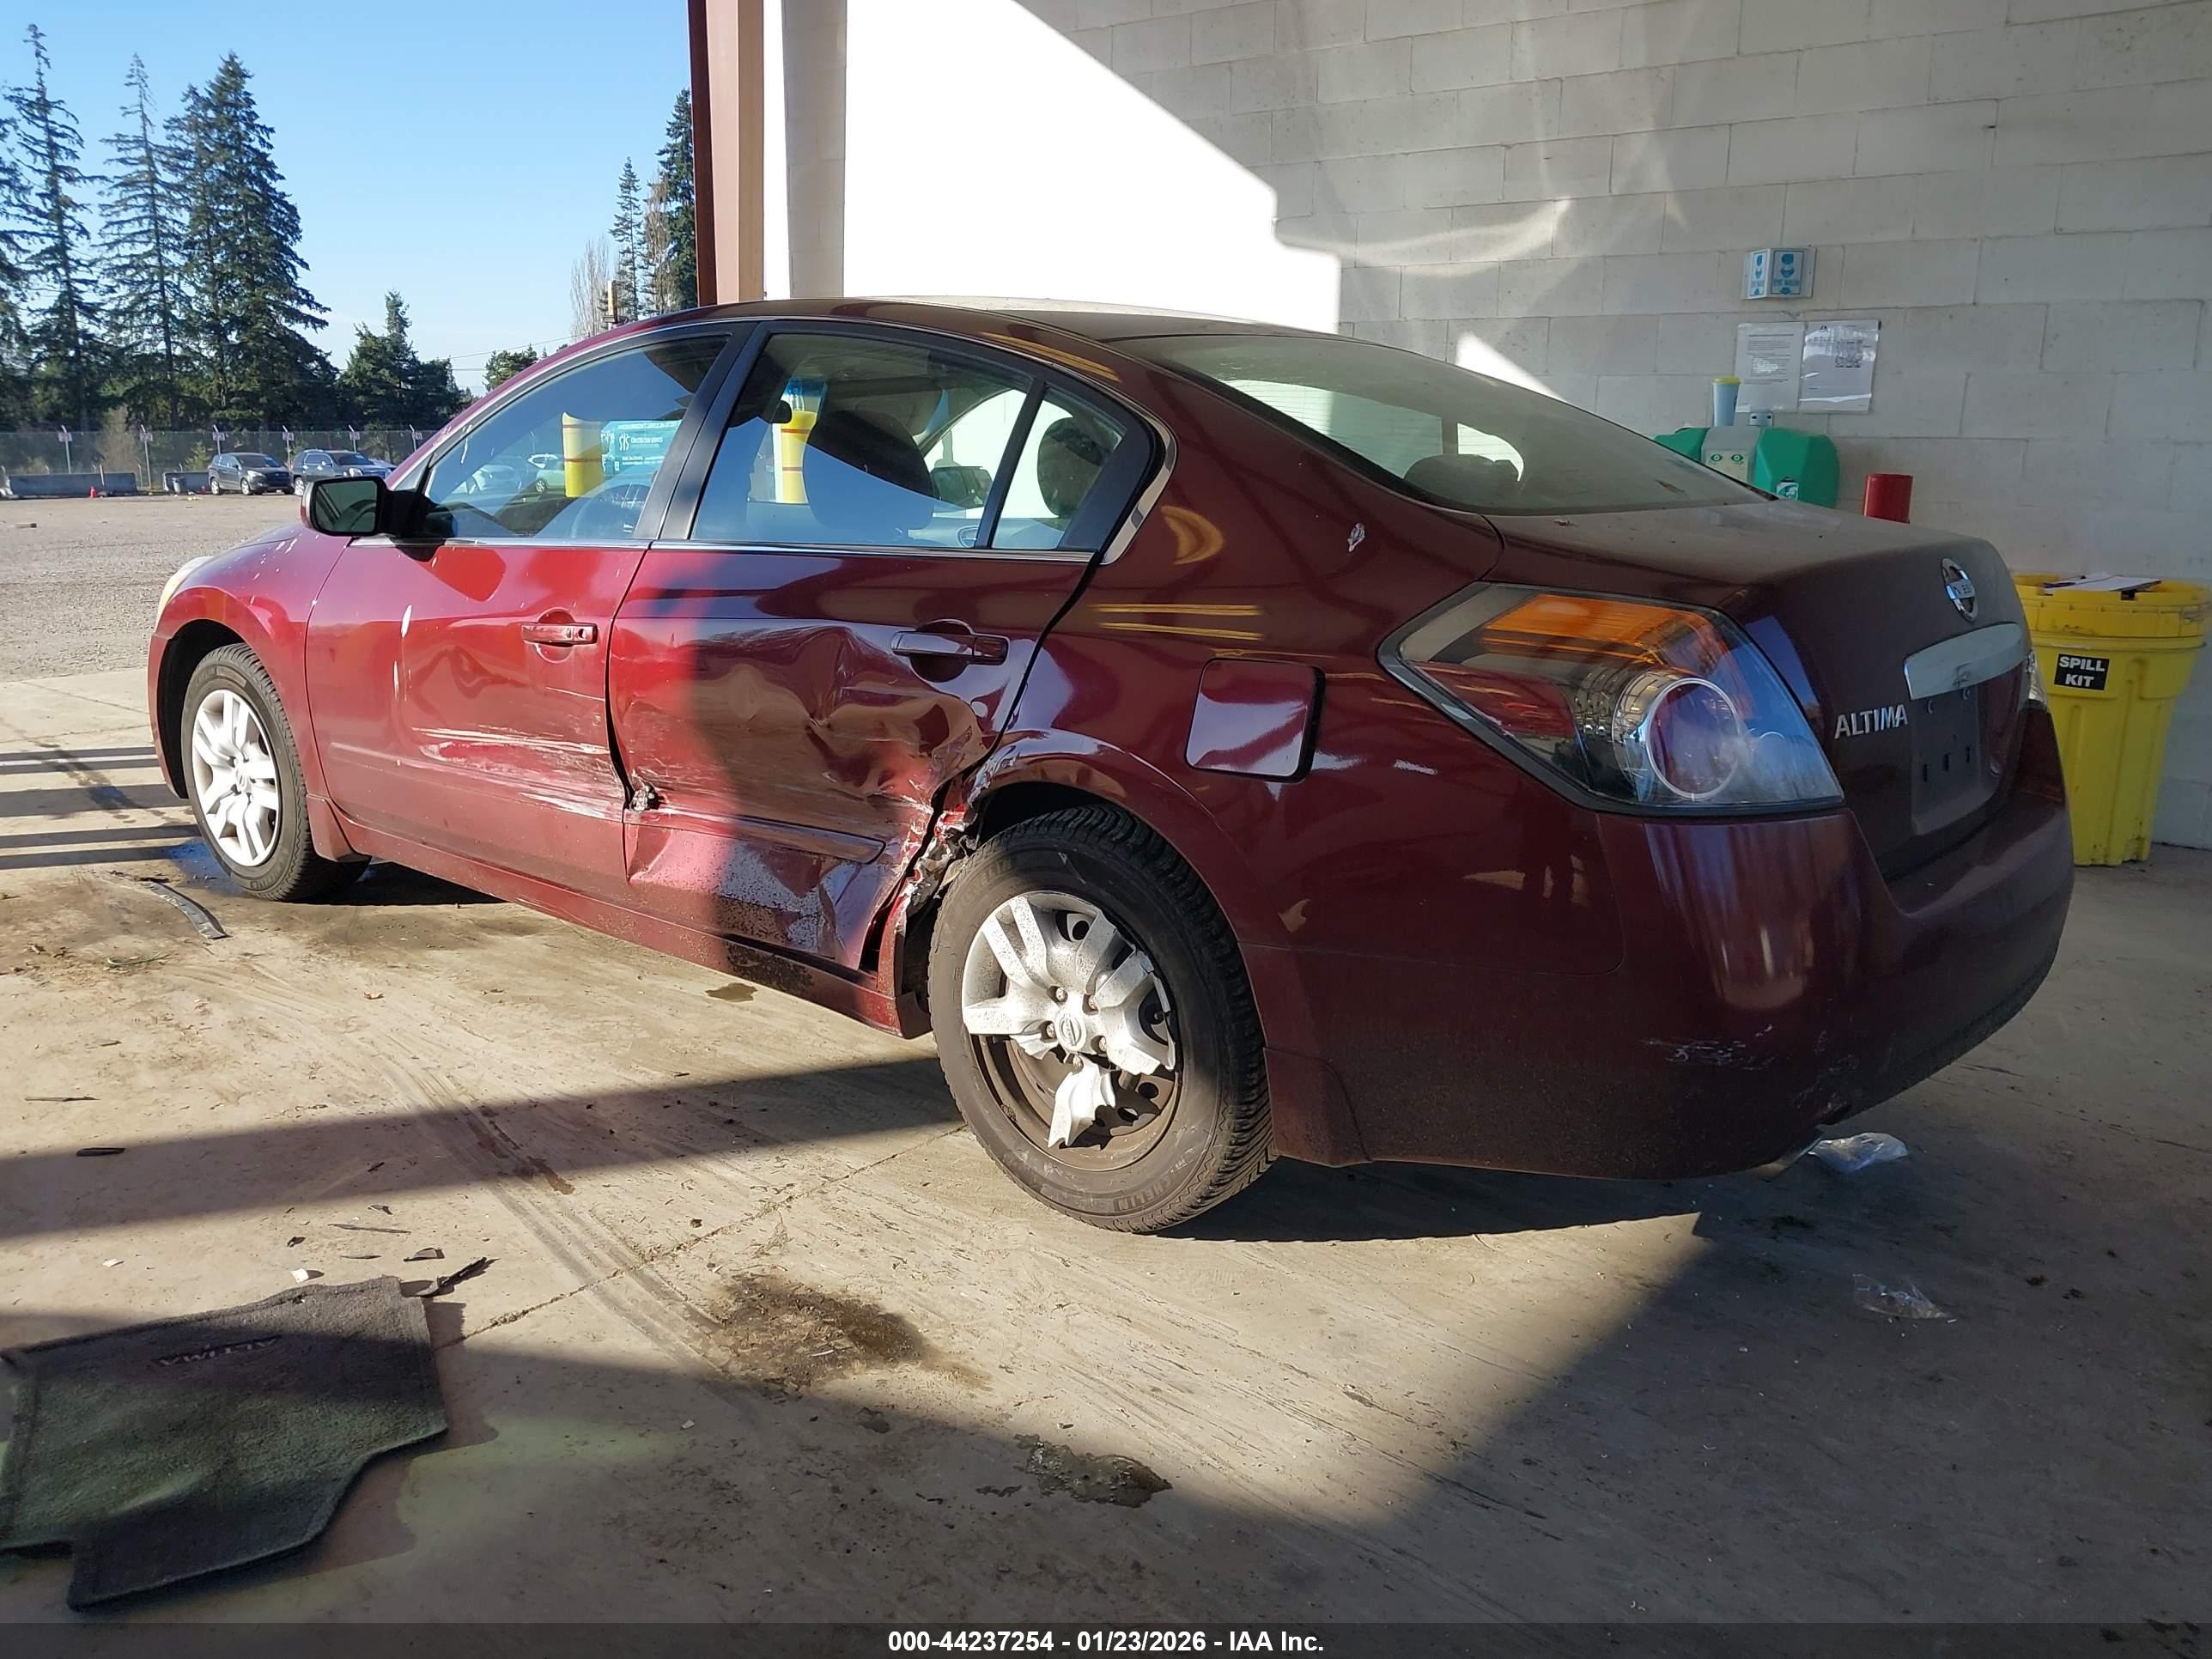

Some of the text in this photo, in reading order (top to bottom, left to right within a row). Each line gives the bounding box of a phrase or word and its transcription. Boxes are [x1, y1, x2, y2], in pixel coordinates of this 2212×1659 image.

[2059, 656, 2106, 672] SPILL
[2065, 673, 2094, 687] KIT
[1833, 703, 1909, 739] ALTIMA
